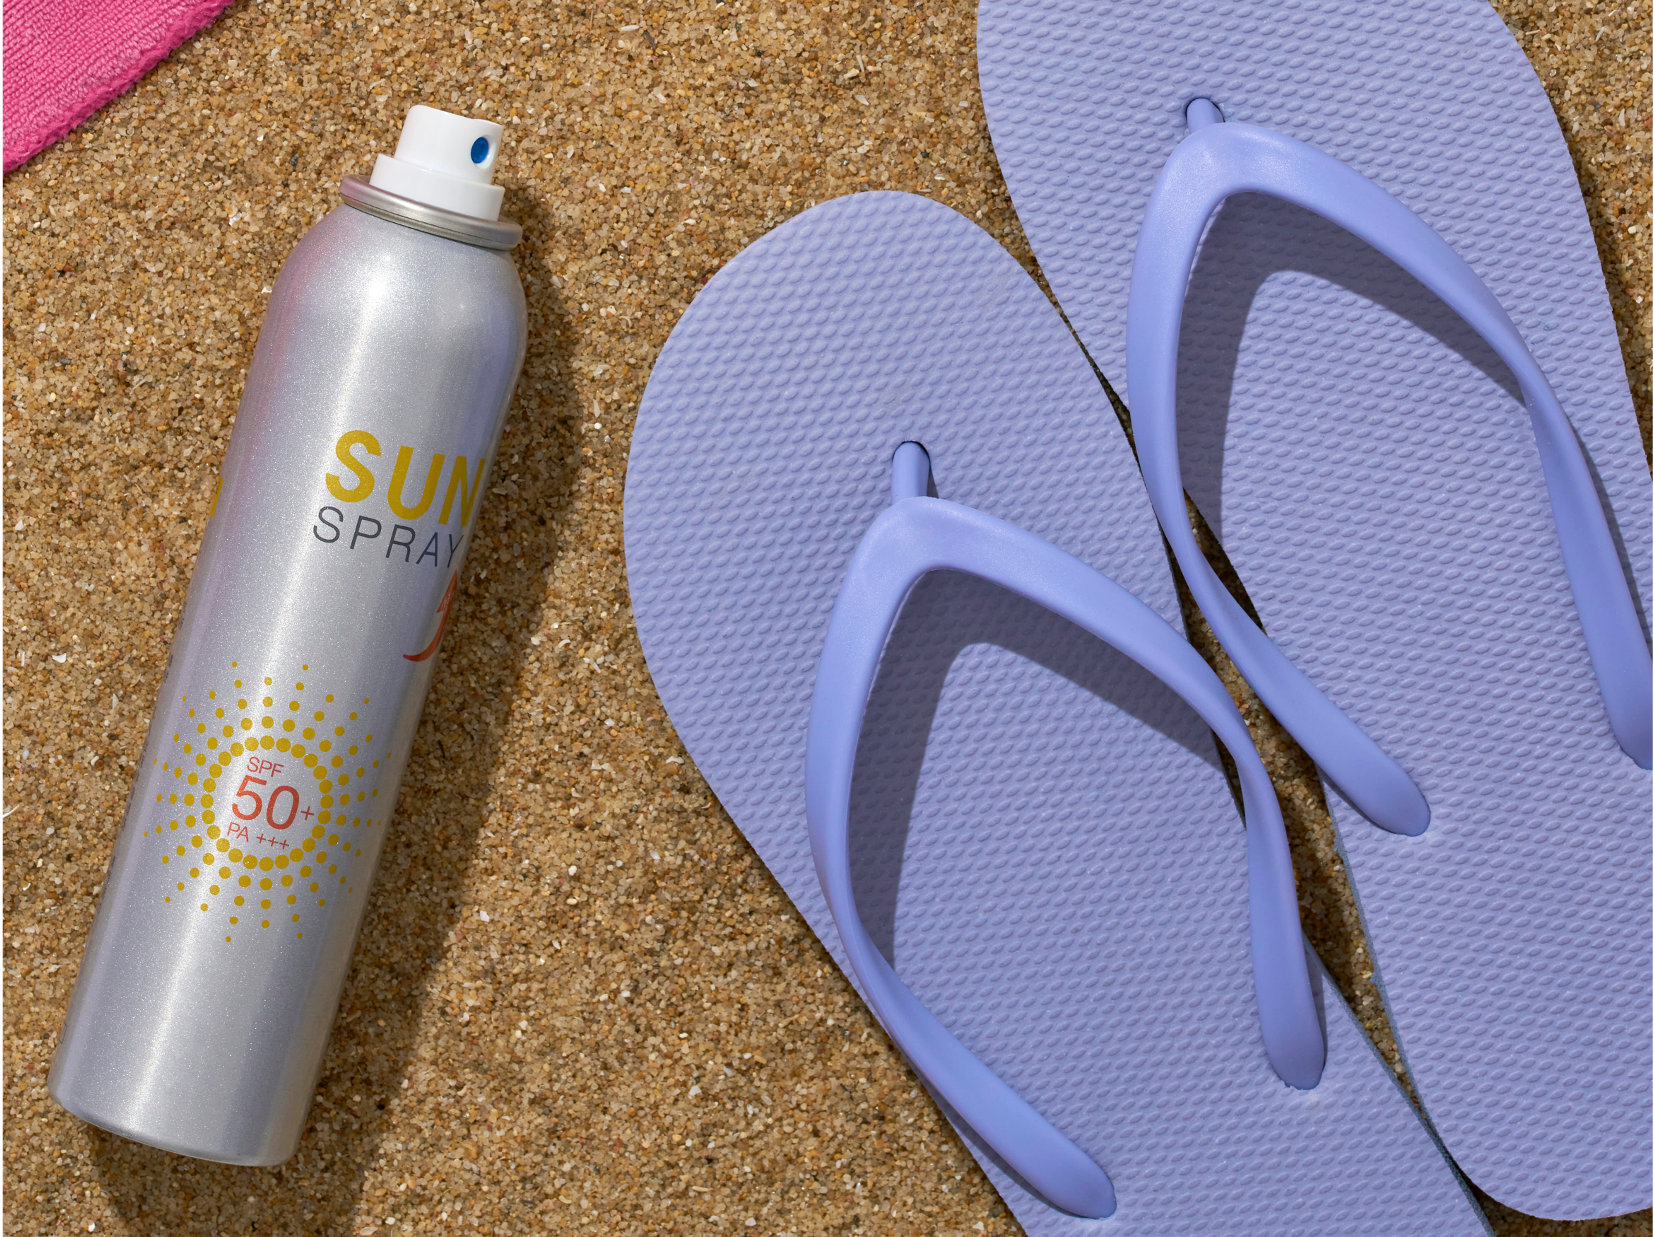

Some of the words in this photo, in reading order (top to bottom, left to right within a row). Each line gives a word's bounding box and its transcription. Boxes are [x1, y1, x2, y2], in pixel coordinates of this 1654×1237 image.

[325, 430, 487, 527] SUN
[313, 506, 464, 569] SPRAY
[247, 756, 284, 778] SPF
[227, 822, 249, 842] PA
